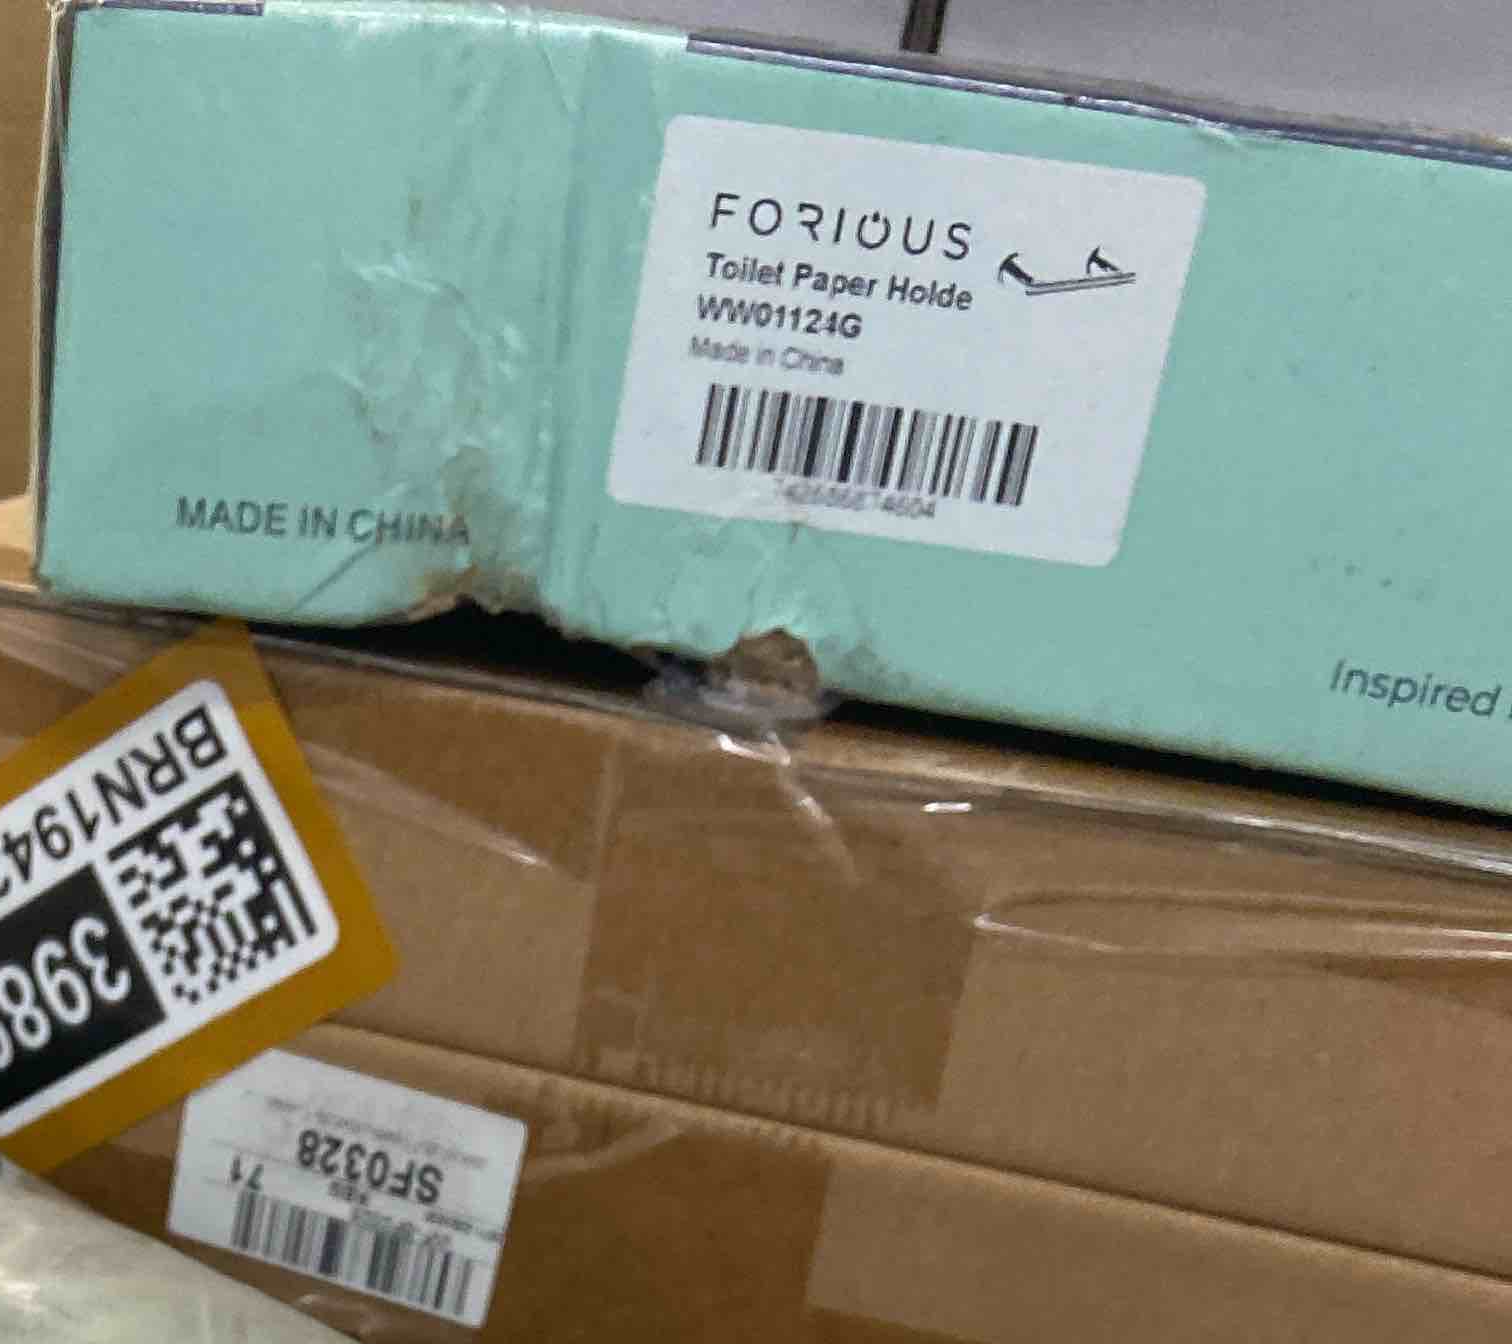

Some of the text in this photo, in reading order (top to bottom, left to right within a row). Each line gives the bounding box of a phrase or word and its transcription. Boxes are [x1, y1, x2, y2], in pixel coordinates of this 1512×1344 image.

[709, 192, 973, 260] FORIOUS
[705, 252, 974, 312] Toilet Paper Holde
[695, 296, 864, 338] WW01124G
[688, 335, 751, 367] Made
[780, 344, 844, 377] China
[176, 496, 471, 546] MADE IN CHINA
[1329, 657, 1502, 718] Inspired
[297, 1128, 444, 1204] SF0328
